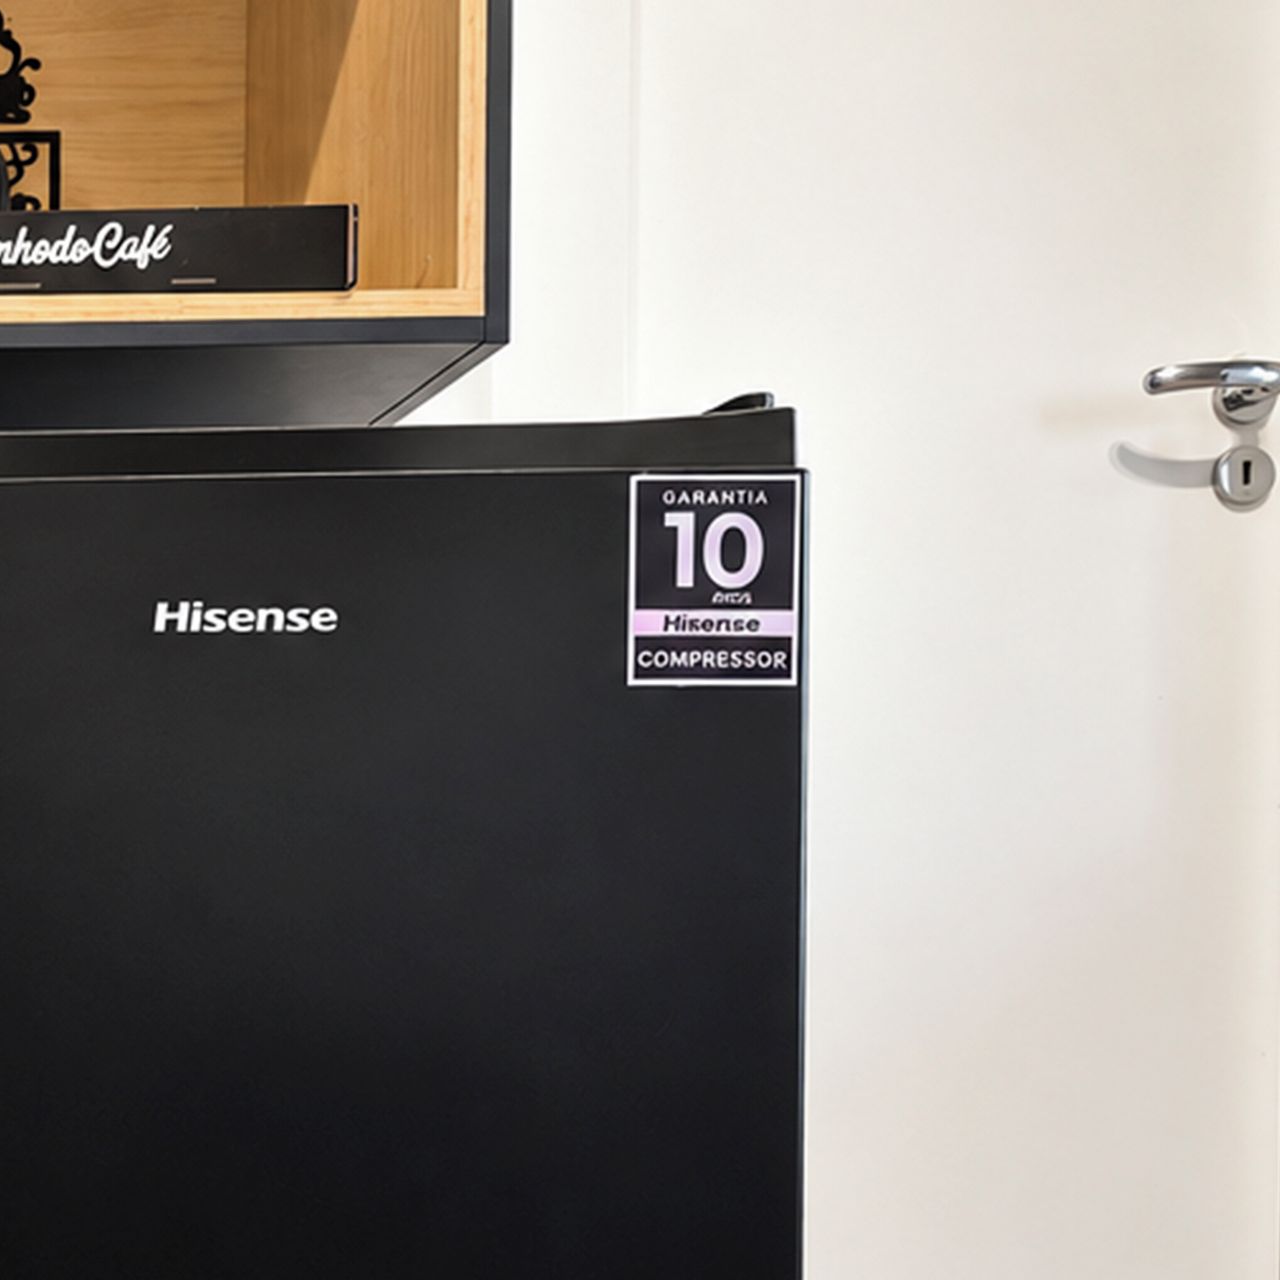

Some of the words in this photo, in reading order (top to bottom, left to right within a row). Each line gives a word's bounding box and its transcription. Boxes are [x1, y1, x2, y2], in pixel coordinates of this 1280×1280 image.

[662, 490, 768, 505] GARANTIA
[664, 511, 764, 589] 10
[153, 601, 338, 633] Hisense
[663, 614, 760, 632] Hisense
[637, 651, 787, 669] COMPRESSOR
